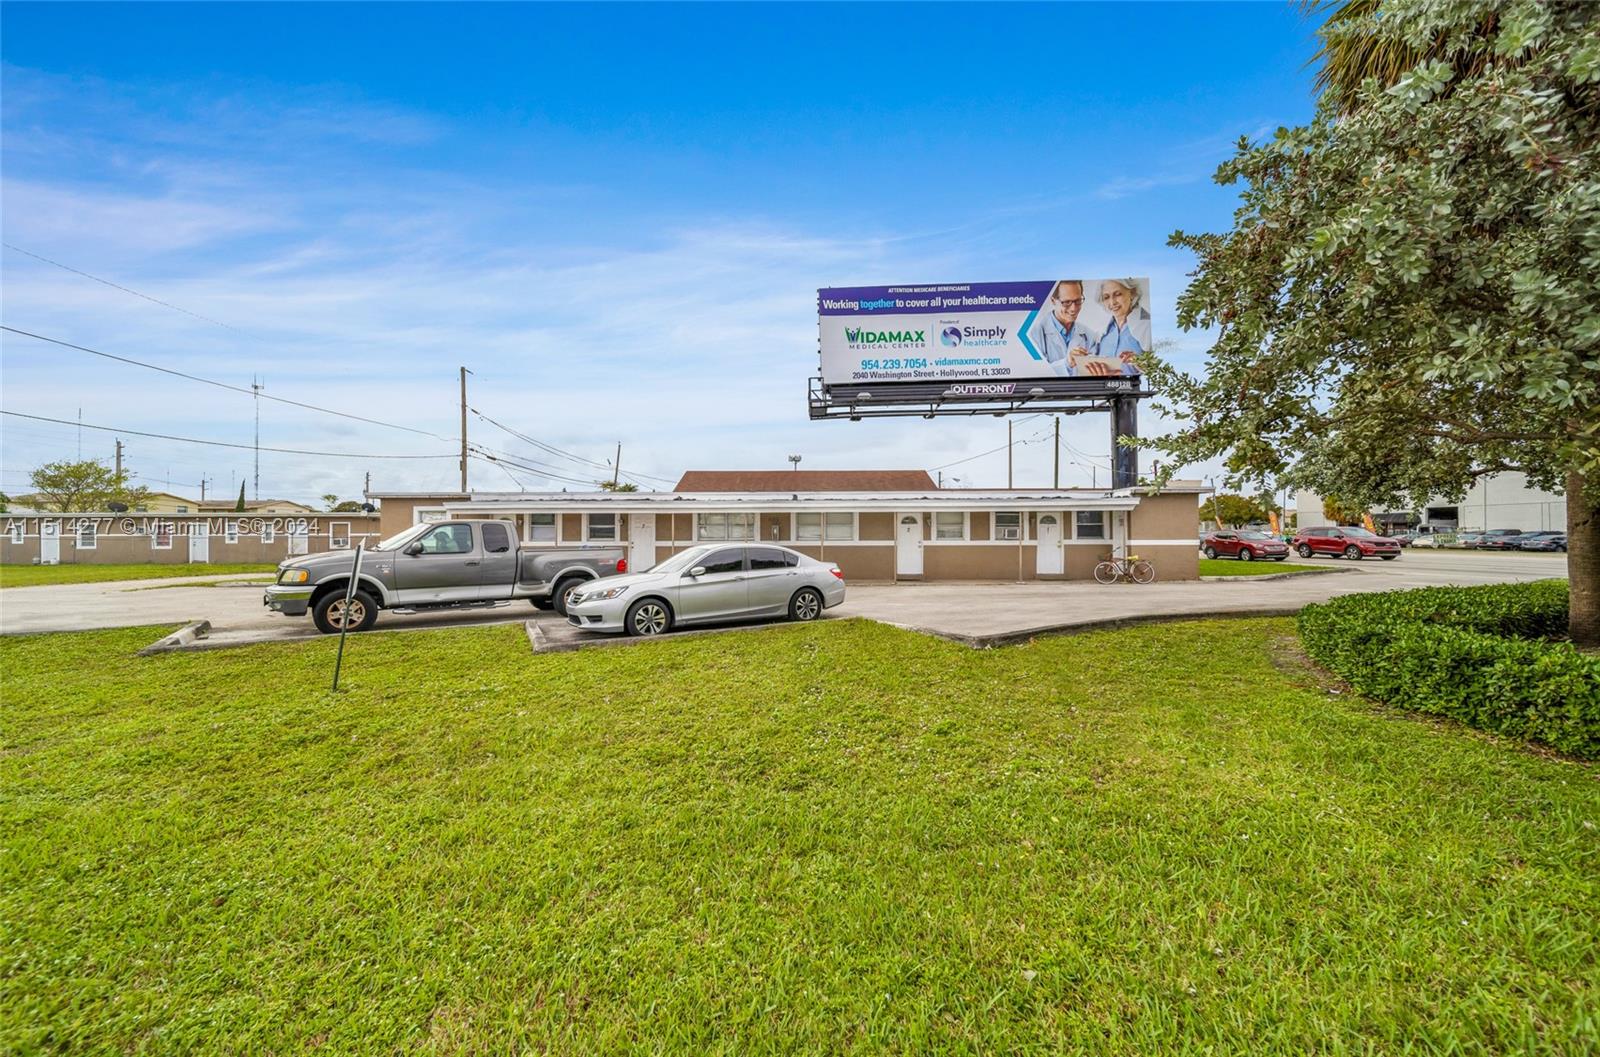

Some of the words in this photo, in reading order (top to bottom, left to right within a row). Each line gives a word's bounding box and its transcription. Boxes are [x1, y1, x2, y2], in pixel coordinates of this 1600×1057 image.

[822, 300, 858, 310] Working
[860, 298, 895, 310] together
[896, 299, 904, 308] to
[906, 299, 929, 308] cover
[930, 297, 940, 306] all
[942, 298, 962, 308] your
[962, 295, 1008, 306] healthcare
[1008, 294, 1036, 304] needs.
[845, 326, 924, 344] VIDAMAX
[964, 326, 1006, 339] Simply
[861, 358, 927, 370] 954.239.7054
[934, 358, 1000, 366] vidamaxmc.com
[870, 370, 912, 379] Washington
[913, 370, 934, 378] Street
[940, 368, 980, 378] Hollywood,
[953, 384, 1011, 394] OUTFRONT
